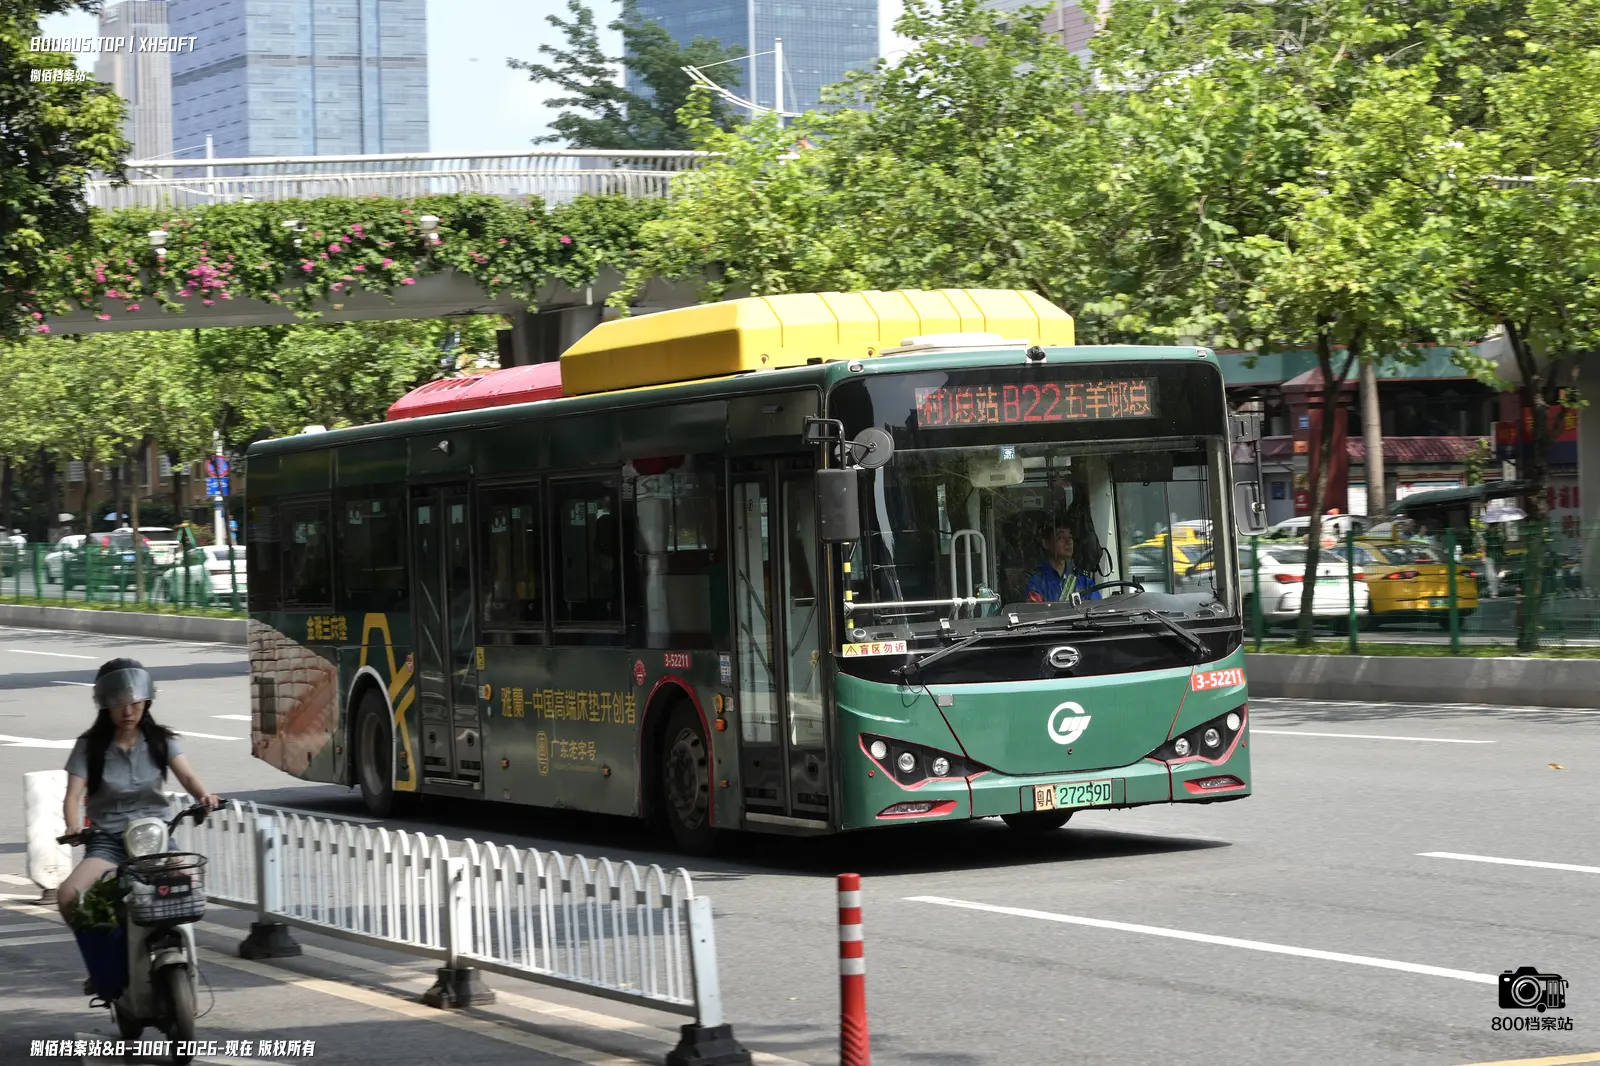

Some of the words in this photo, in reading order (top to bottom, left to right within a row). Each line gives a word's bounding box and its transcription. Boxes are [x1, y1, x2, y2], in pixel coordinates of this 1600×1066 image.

[1002, 383, 1063, 423] B22
[859, 642, 905, 656] 盲区勿近
[664, 652, 690, 669] 3-52211
[1195, 669, 1243, 689] 3-52211
